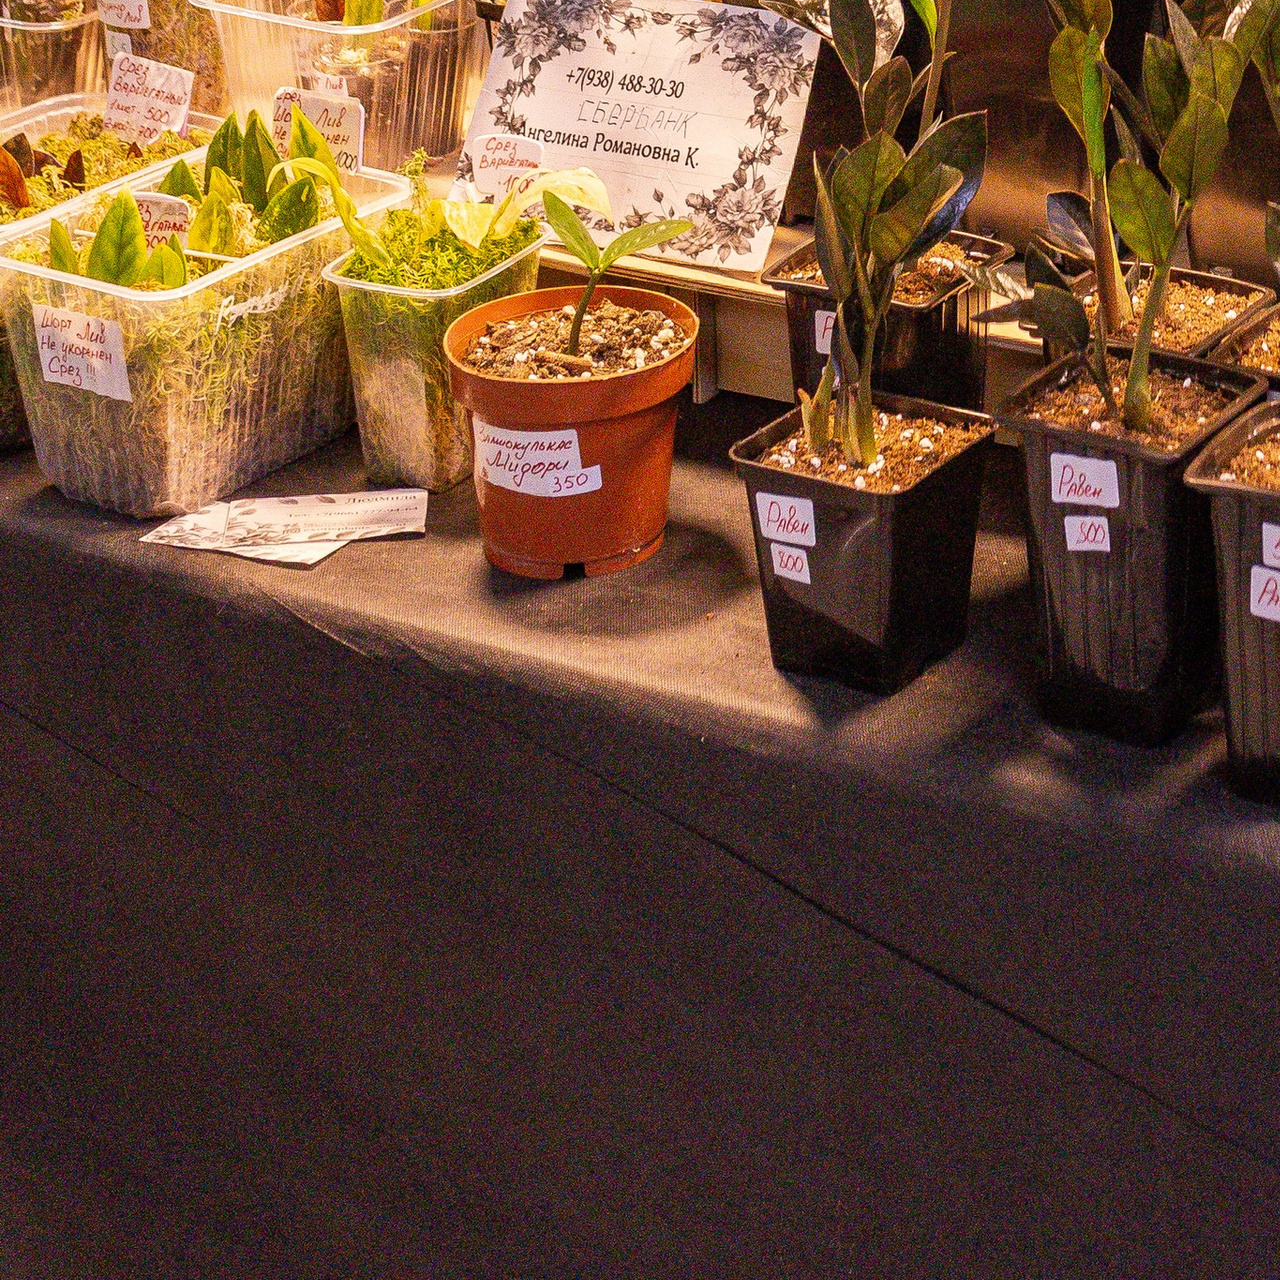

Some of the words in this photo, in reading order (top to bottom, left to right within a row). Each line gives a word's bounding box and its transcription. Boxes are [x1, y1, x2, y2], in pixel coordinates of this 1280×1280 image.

[118, 56, 149, 86] Срез
[566, 66, 615, 96] +7(938)
[617, 73, 685, 99] 488-30-30
[144, 106, 171, 125] 500
[315, 106, 347, 128] Лив
[485, 136, 518, 162] Срез
[593, 132, 681, 163] Романовна
[685, 146, 700, 169] К.
[41, 311, 72, 332] Шорт
[77, 322, 107, 345] Лив
[40, 335, 57, 352] Не
[48, 357, 84, 387] Срез
[486, 449, 570, 487] Мидори
[552, 472, 588, 493] 350
[1058, 464, 1103, 499] Равен
[766, 500, 810, 535] Равен
